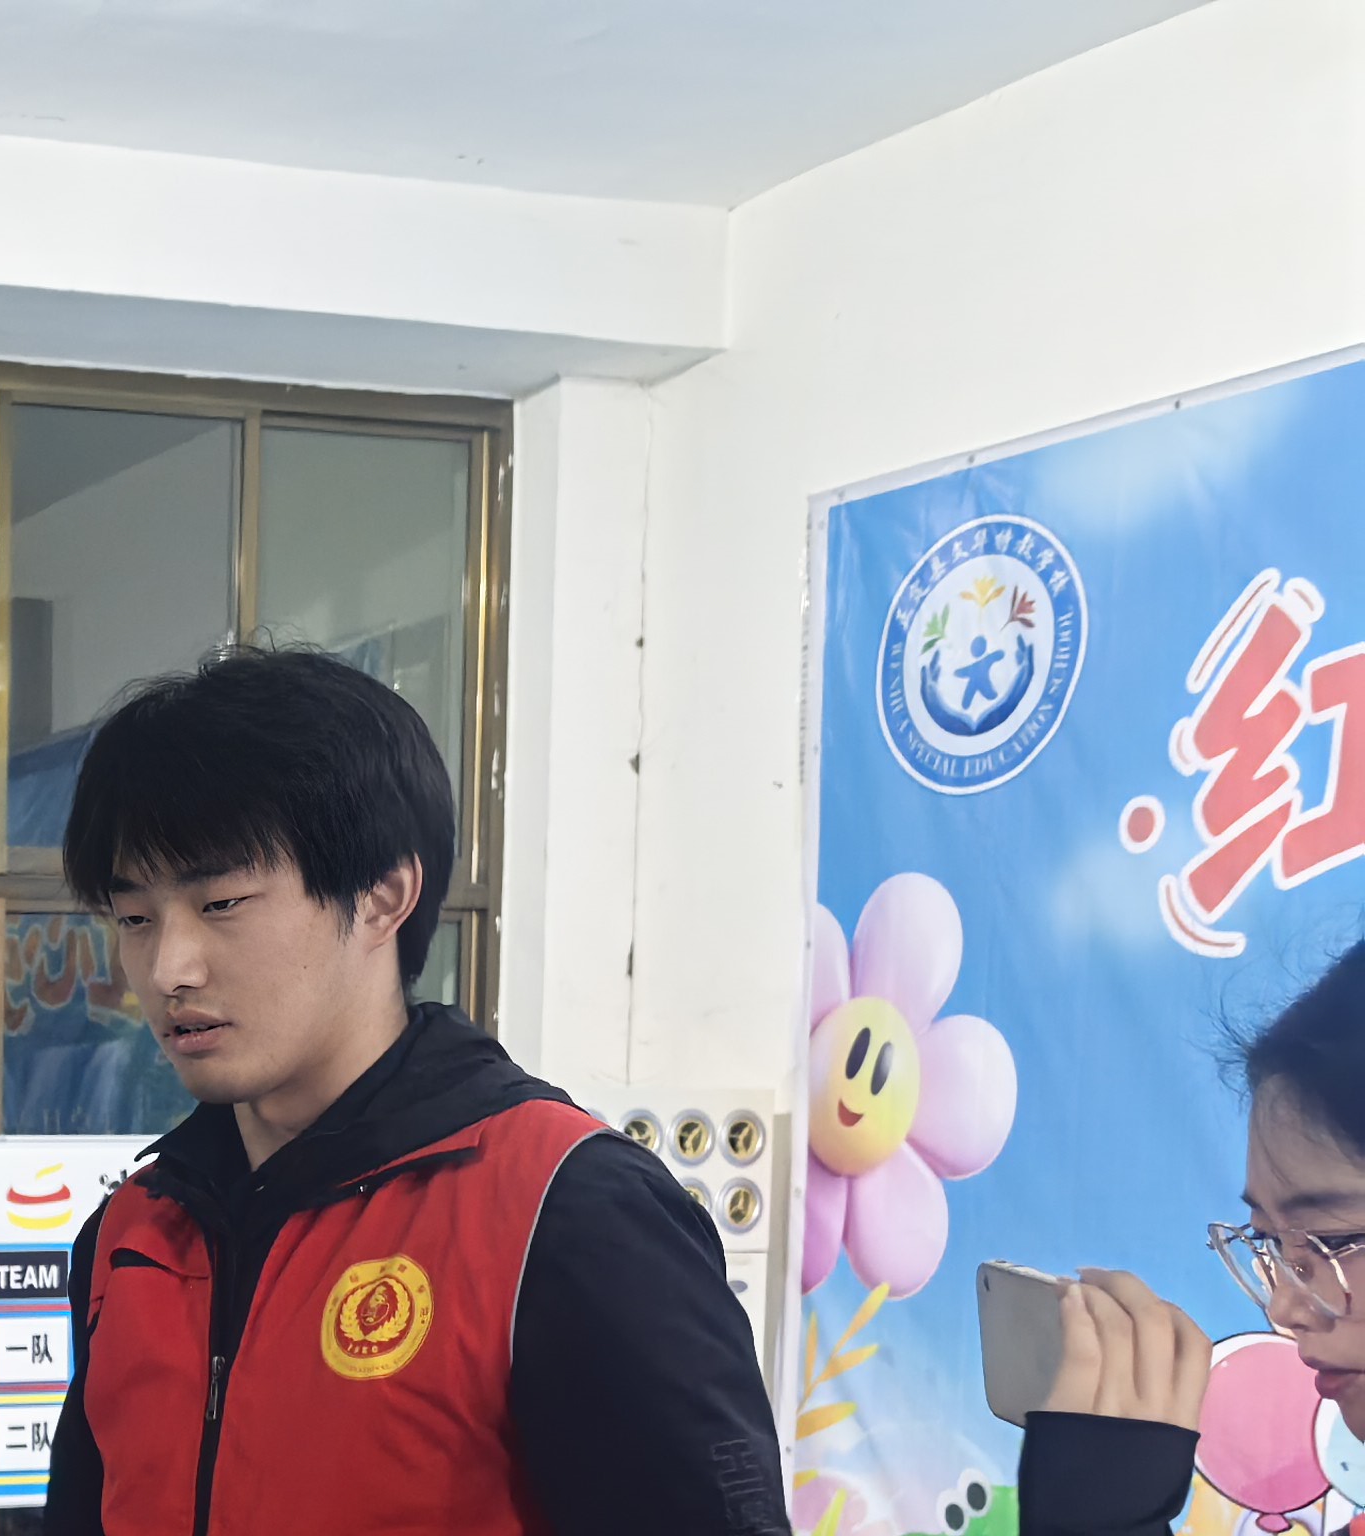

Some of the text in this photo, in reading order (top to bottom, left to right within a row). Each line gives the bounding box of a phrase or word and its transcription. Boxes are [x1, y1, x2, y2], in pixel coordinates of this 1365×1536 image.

[906, 730, 960, 778] SPECIAL
[963, 702, 1055, 779] EDUCATION
[1181, 592, 1365, 924] 红
[5, 1333, 53, 1364] 一队
[5, 1422, 51, 1451] 二队
